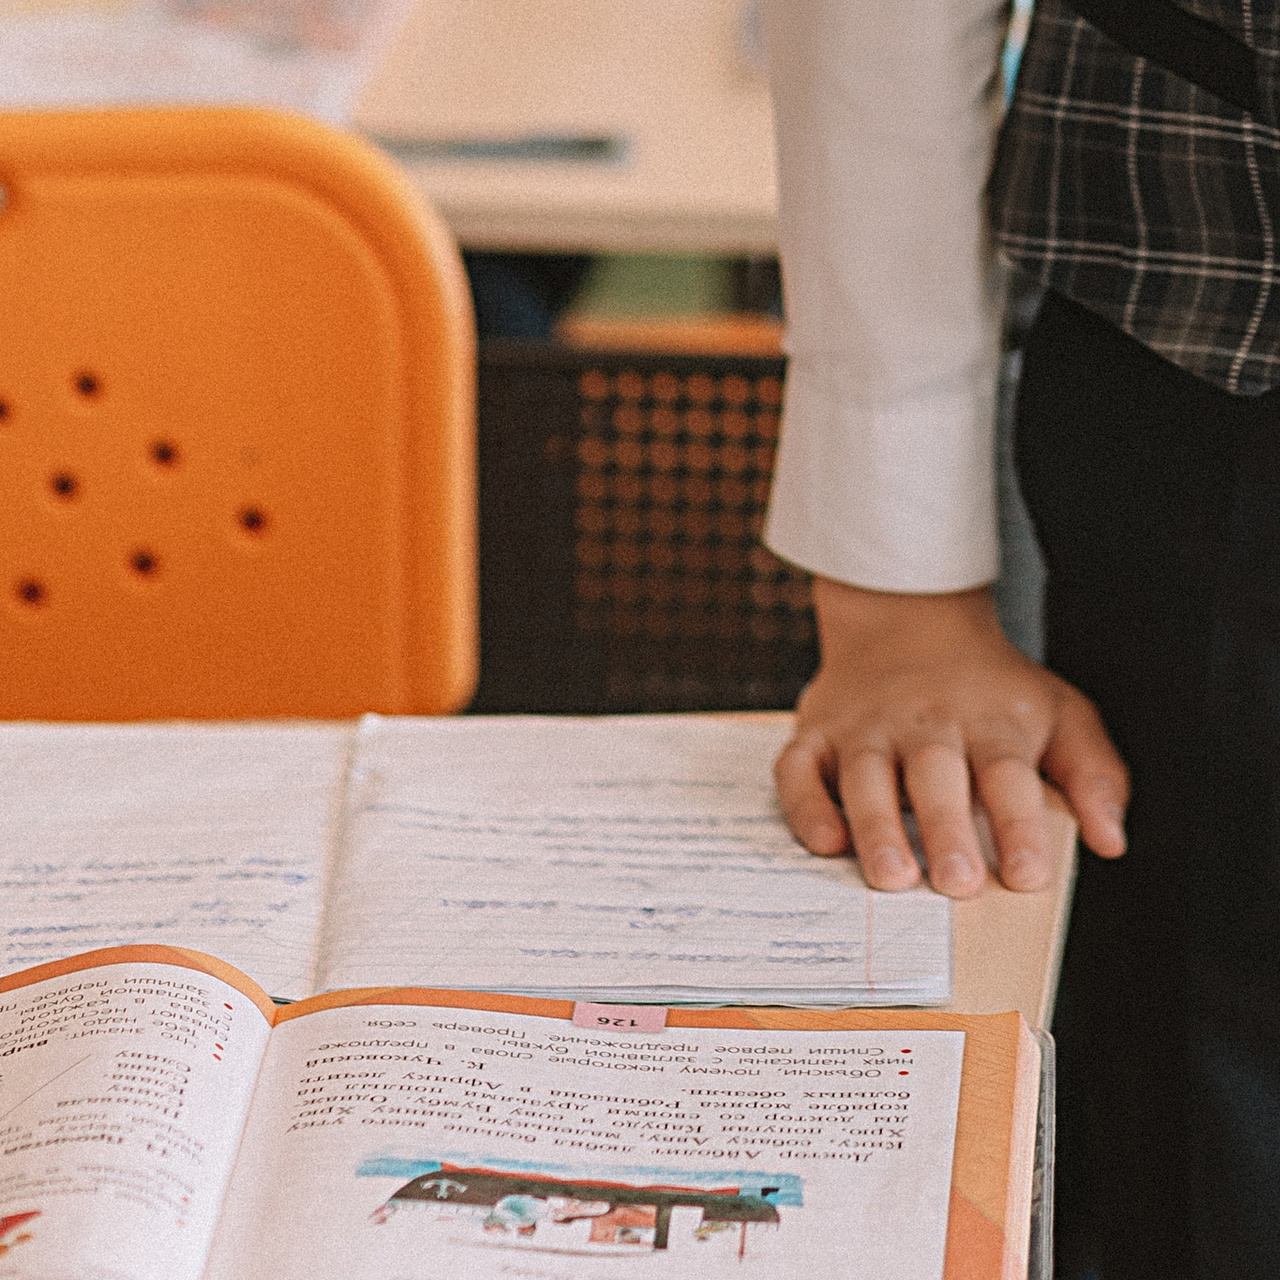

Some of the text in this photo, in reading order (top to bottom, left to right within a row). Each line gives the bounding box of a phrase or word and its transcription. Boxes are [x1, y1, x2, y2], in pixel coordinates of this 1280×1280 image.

[32, 981, 107, 1003] первое
[124, 978, 208, 998] Запиши
[15, 994, 84, 1016] буквы.
[100, 988, 210, 1008] заглавной
[20, 999, 109, 1024] каждом
[83, 1017, 137, 1026] надо
[596, 1017, 639, 1027] 126
[152, 1021, 198, 1040] Тебе
[161, 1032, 196, 1048] Что
[362, 1020, 885, 1056] Спиши первое предложение. Проверь себя.
[0, 1039, 48, 1057] выр
[309, 1038, 429, 1053] предложе-
[496, 1039, 569, 1054] буквы.
[470, 1047, 533, 1060] слова
[584, 1049, 697, 1063] заглавной
[306, 1054, 485, 1070] К. Чуковский
[548, 1056, 665, 1072] некоторые
[738, 1058, 846, 1066] написаны
[863, 1058, 914, 1066] ниях
[299, 1072, 386, 1084] лечить
[680, 1066, 761, 1076] почему
[776, 1068, 881, 1078] Объясни,
[401, 1073, 503, 1090] Африку
[297, 1086, 323, 1096] на
[345, 1084, 443, 1094] поплыл
[680, 1088, 910, 1100] больных обезьян.
[293, 1094, 388, 1108] Однаж-
[464, 1090, 588, 1111] друзьями
[549, 1089, 680, 1109] Робинзона
[699, 1100, 791, 1109] моряка
[372, 1106, 462, 1121] свинку
[606, 1108, 700, 1120] своими
[807, 1103, 908, 1112] корабле
[509, 1108, 564, 1122] сову
[764, 1113, 854, 1122] доктор
[873, 1115, 908, 1124] ды
[477, 1116, 620, 1140] маленькую
[611, 1119, 703, 1133] Карудо
[722, 1125, 823, 1135] попугая
[284, 1117, 872, 1162] Доктор Айболит любил больше всего утку
[639, 1133, 710, 1146] Авву,
[726, 1137, 811, 1147] собаку
[829, 1139, 904, 1150] Кику,
